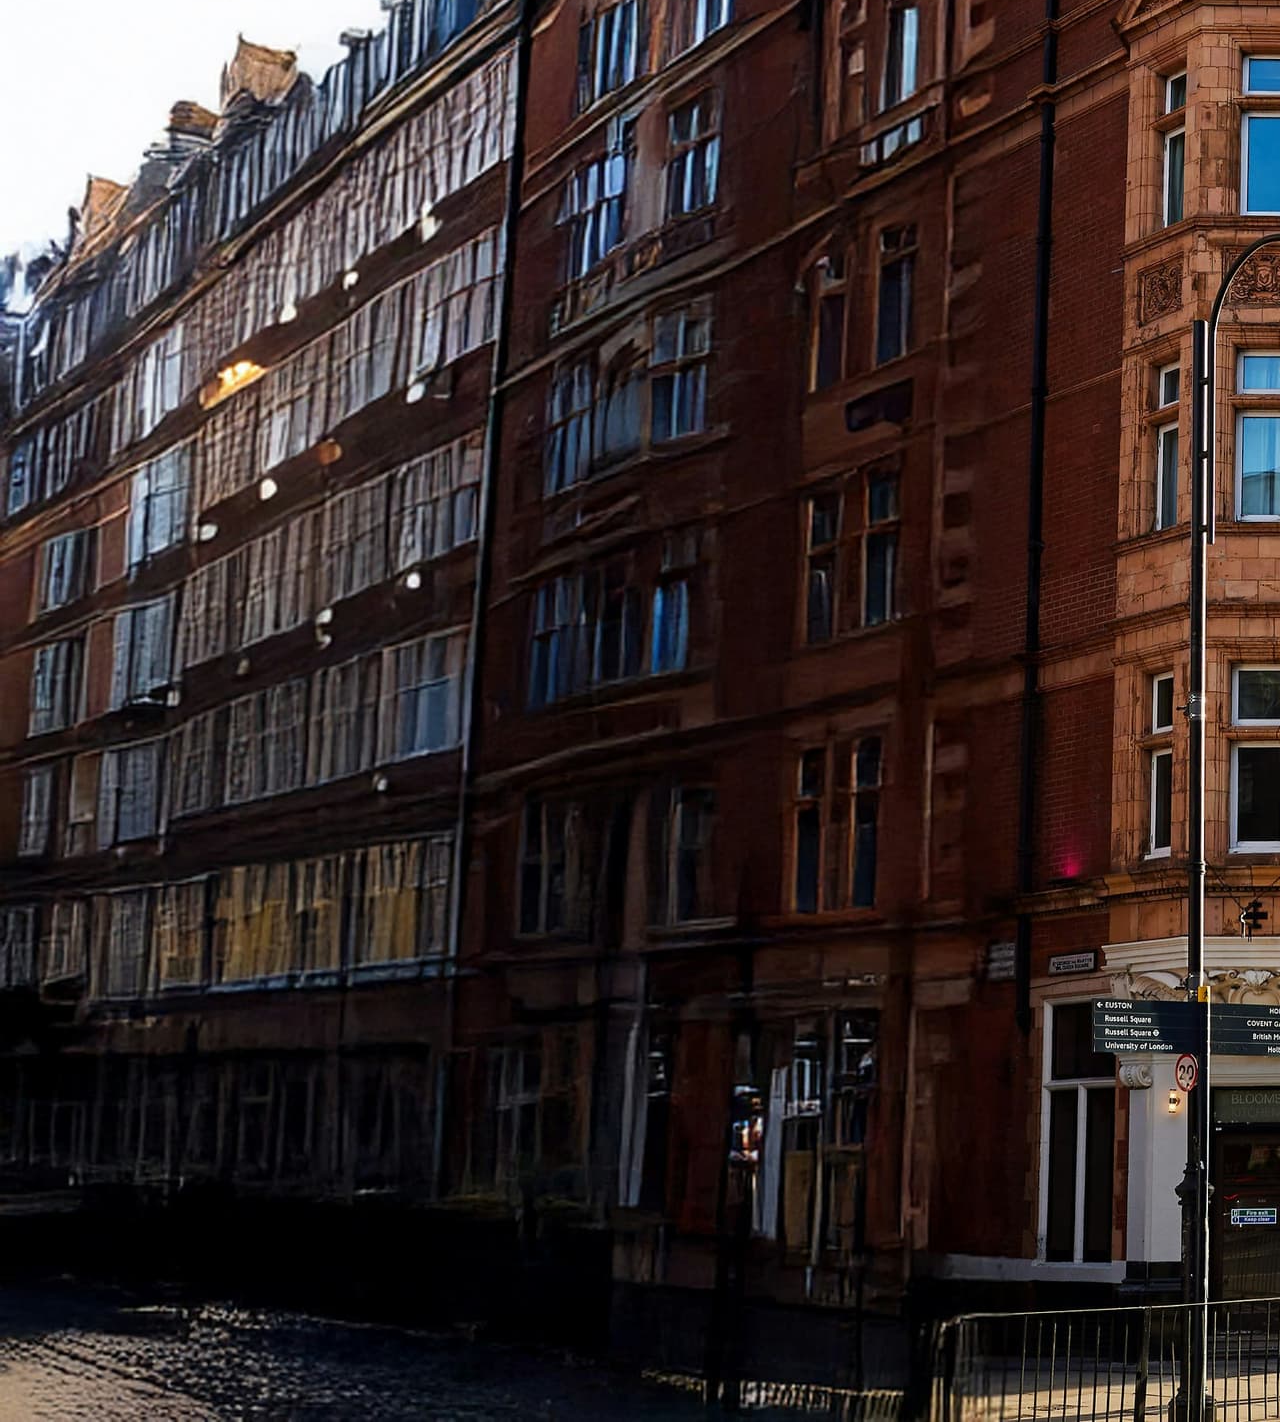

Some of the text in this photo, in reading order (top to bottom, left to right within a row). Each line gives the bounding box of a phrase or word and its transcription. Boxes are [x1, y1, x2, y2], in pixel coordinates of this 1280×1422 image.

[1105, 1001, 1133, 1009] EUSTON
[1104, 1014, 1152, 1024] Russell Square
[1104, 1028, 1152, 1038] Russell Square
[1105, 1041, 1139, 1051] University
